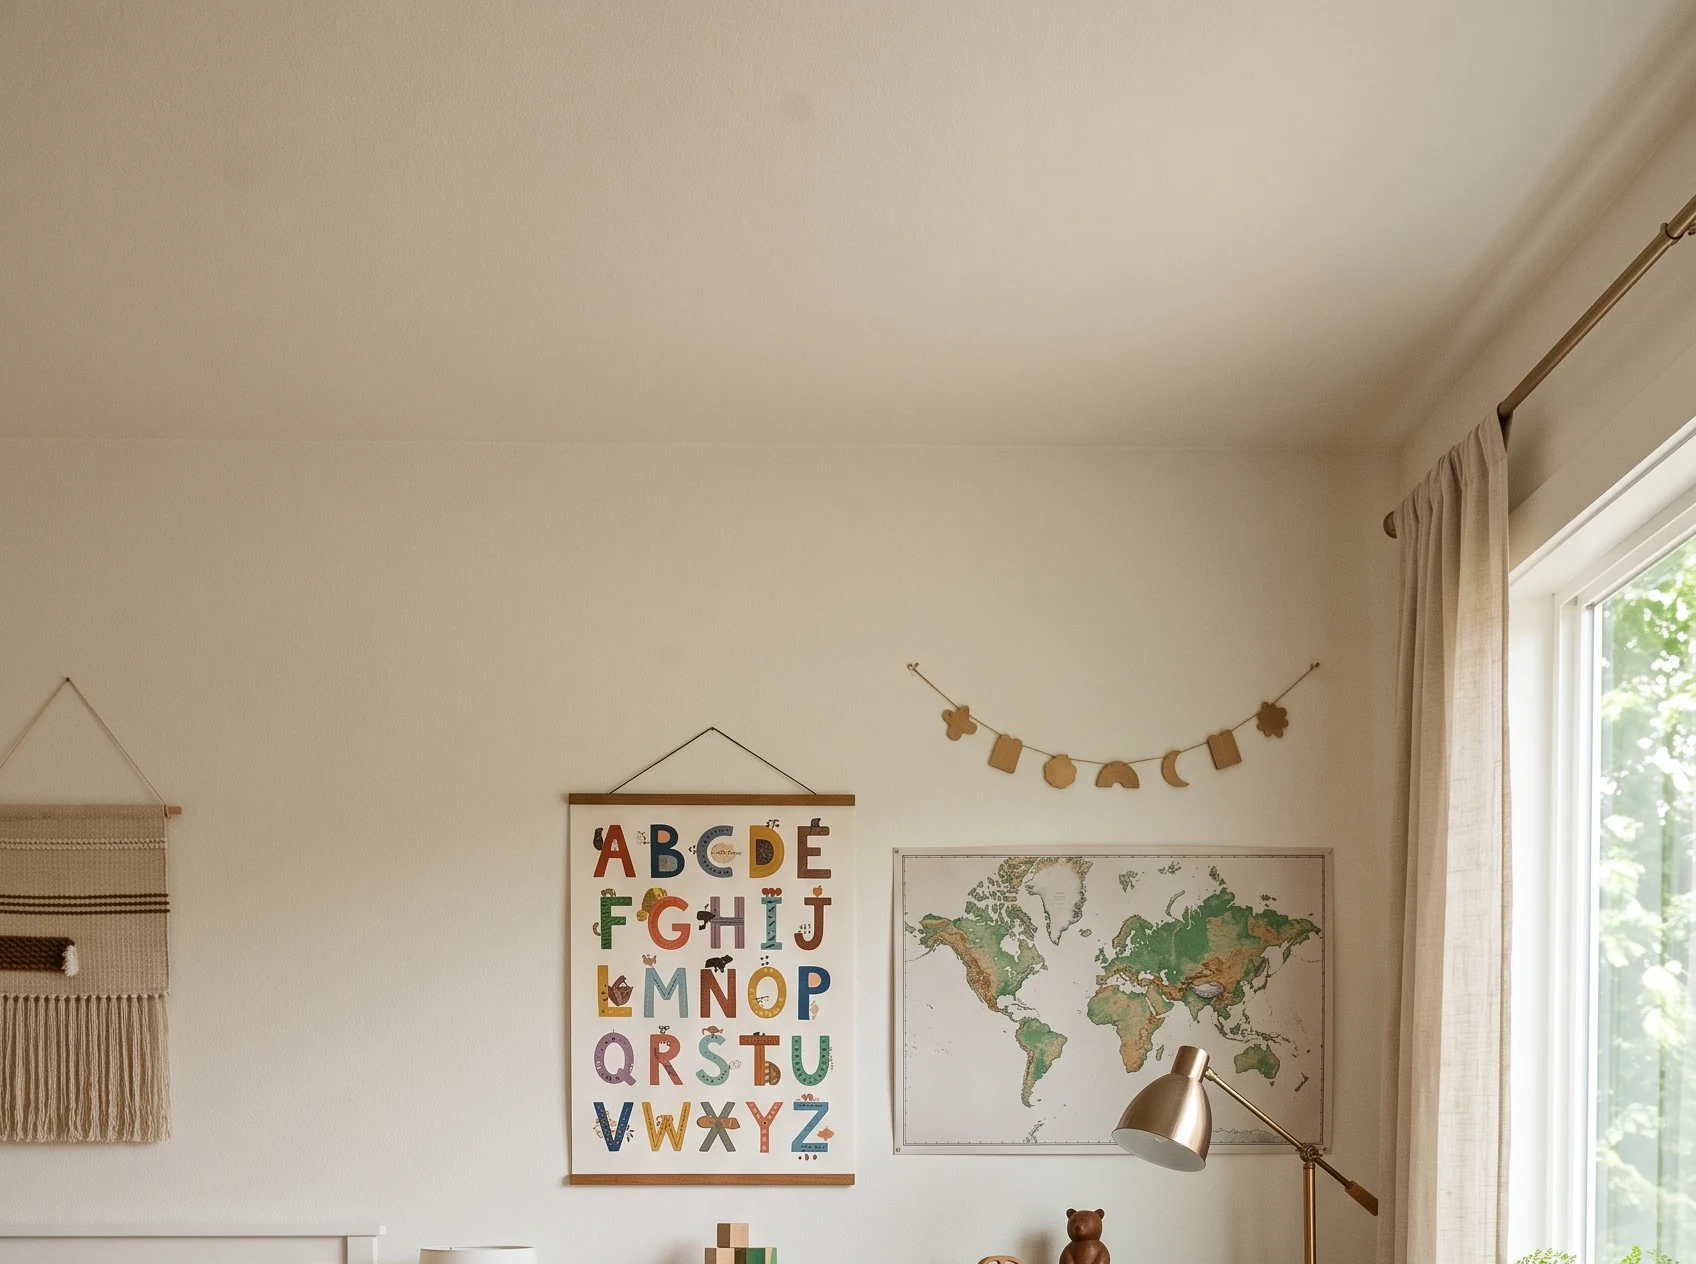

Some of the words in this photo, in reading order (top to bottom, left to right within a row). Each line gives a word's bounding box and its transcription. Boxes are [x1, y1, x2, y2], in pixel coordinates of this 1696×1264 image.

[593, 825, 636, 878] A
[651, 825, 685, 878] B
[697, 825, 734, 877] C
[750, 825, 784, 878] D
[797, 826, 831, 878] E
[601, 897, 632, 949] F
[648, 896, 691, 950] G
[711, 897, 745, 948] H
[761, 897, 782, 950] I
[794, 897, 832, 950] J
[597, 965, 632, 1017] L
[644, 968, 688, 1018] M
[701, 969, 736, 1018] N
[747, 966, 787, 1019] O
[799, 966, 831, 1020] P
[594, 1032, 637, 1086] Q
[650, 1034, 683, 1085] R
[696, 1035, 730, 1085] S
[740, 1035, 780, 1086] T
[792, 1035, 829, 1086] U
[593, 1102, 634, 1152] V
[642, 1102, 691, 1152] W
[699, 1102, 735, 1152] X
[746, 1102, 784, 1153] Y
[791, 1102, 828, 1153] Z
